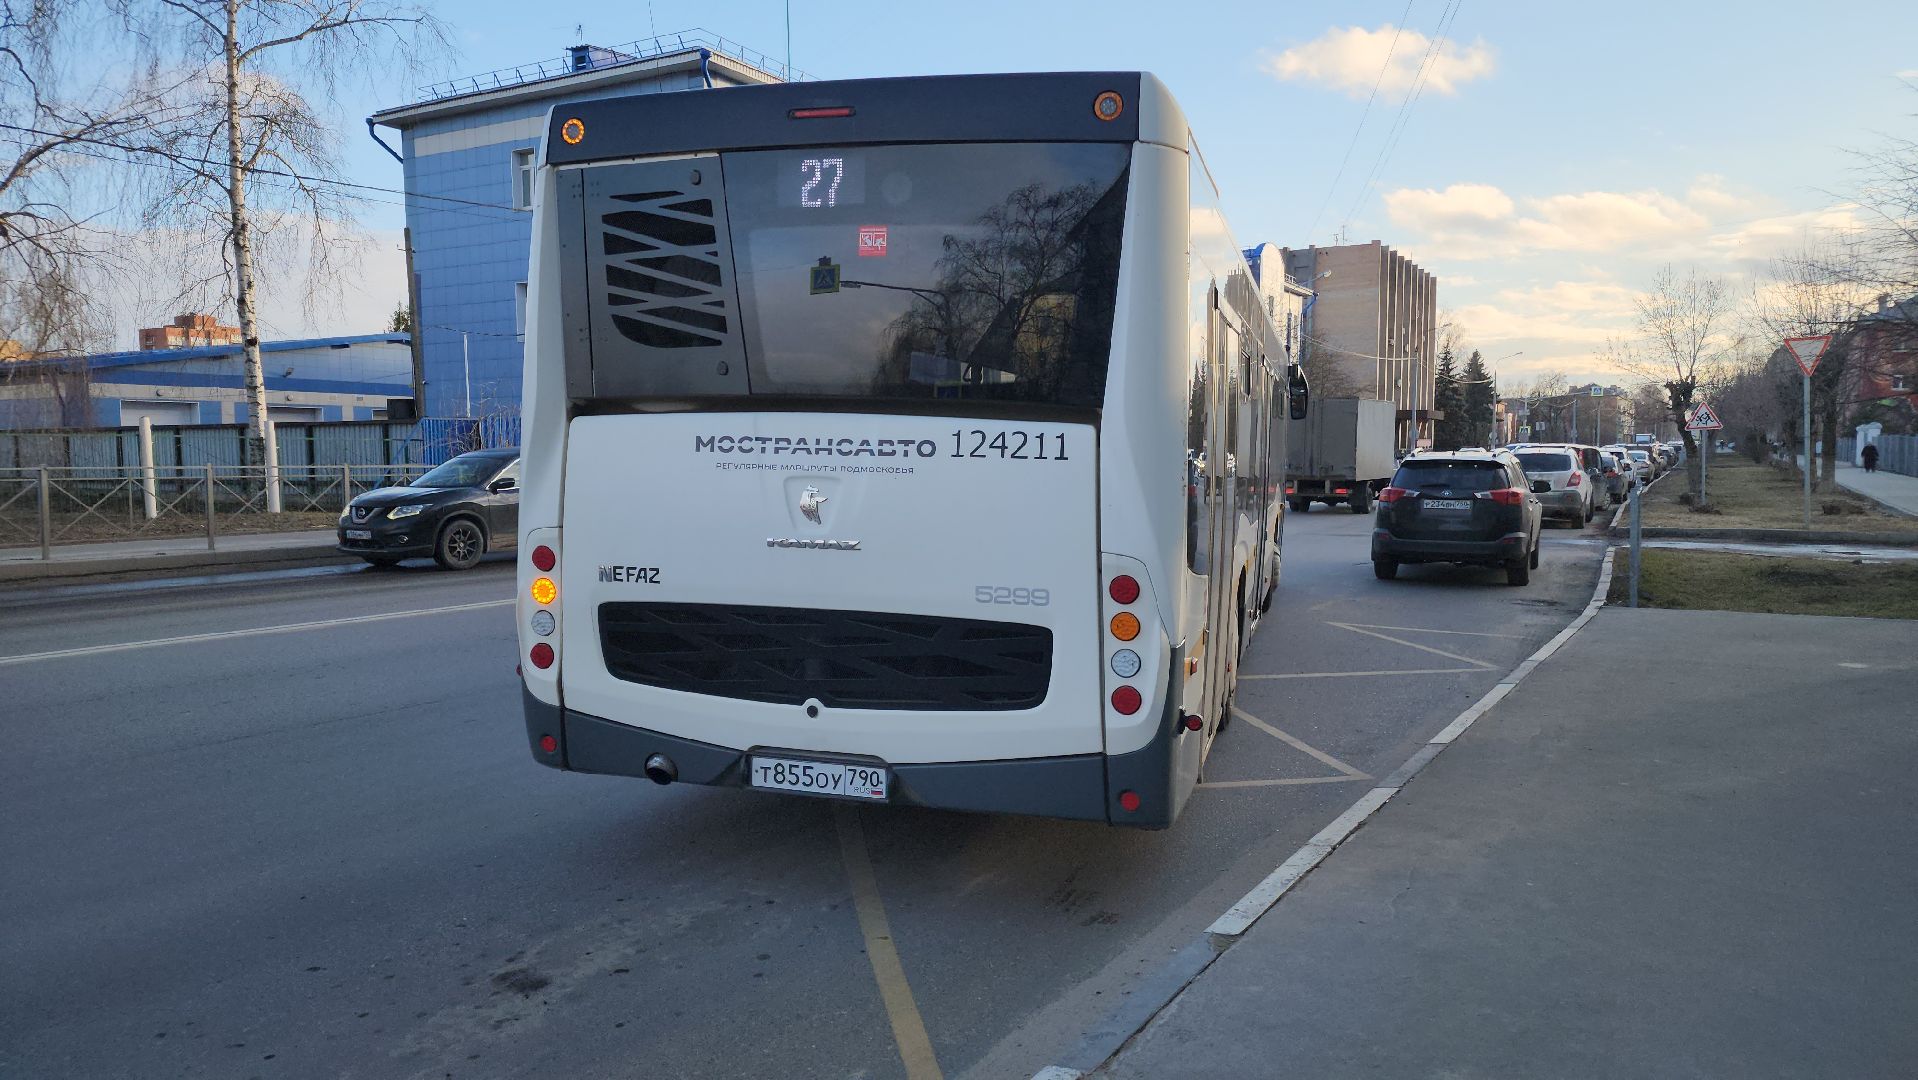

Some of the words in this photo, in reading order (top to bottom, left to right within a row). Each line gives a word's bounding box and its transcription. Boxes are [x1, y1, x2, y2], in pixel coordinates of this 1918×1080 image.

[801, 158, 842, 208] 27
[695, 434, 937, 459] МОСТРАНСАВТО
[950, 430, 1069, 460] 124211
[716, 462, 777, 472] РЕГУЛЯРНЫЕ
[780, 464, 837, 474] МАРШРУТЫ
[840, 465, 915, 475] ПОДМОСКОВЬЯ
[767, 538, 862, 551] KAMAZ
[599, 565, 661, 584] NEFAZ
[975, 585, 1049, 606] 5299
[847, 768, 880, 787] 790
[853, 787, 871, 795] RUS
